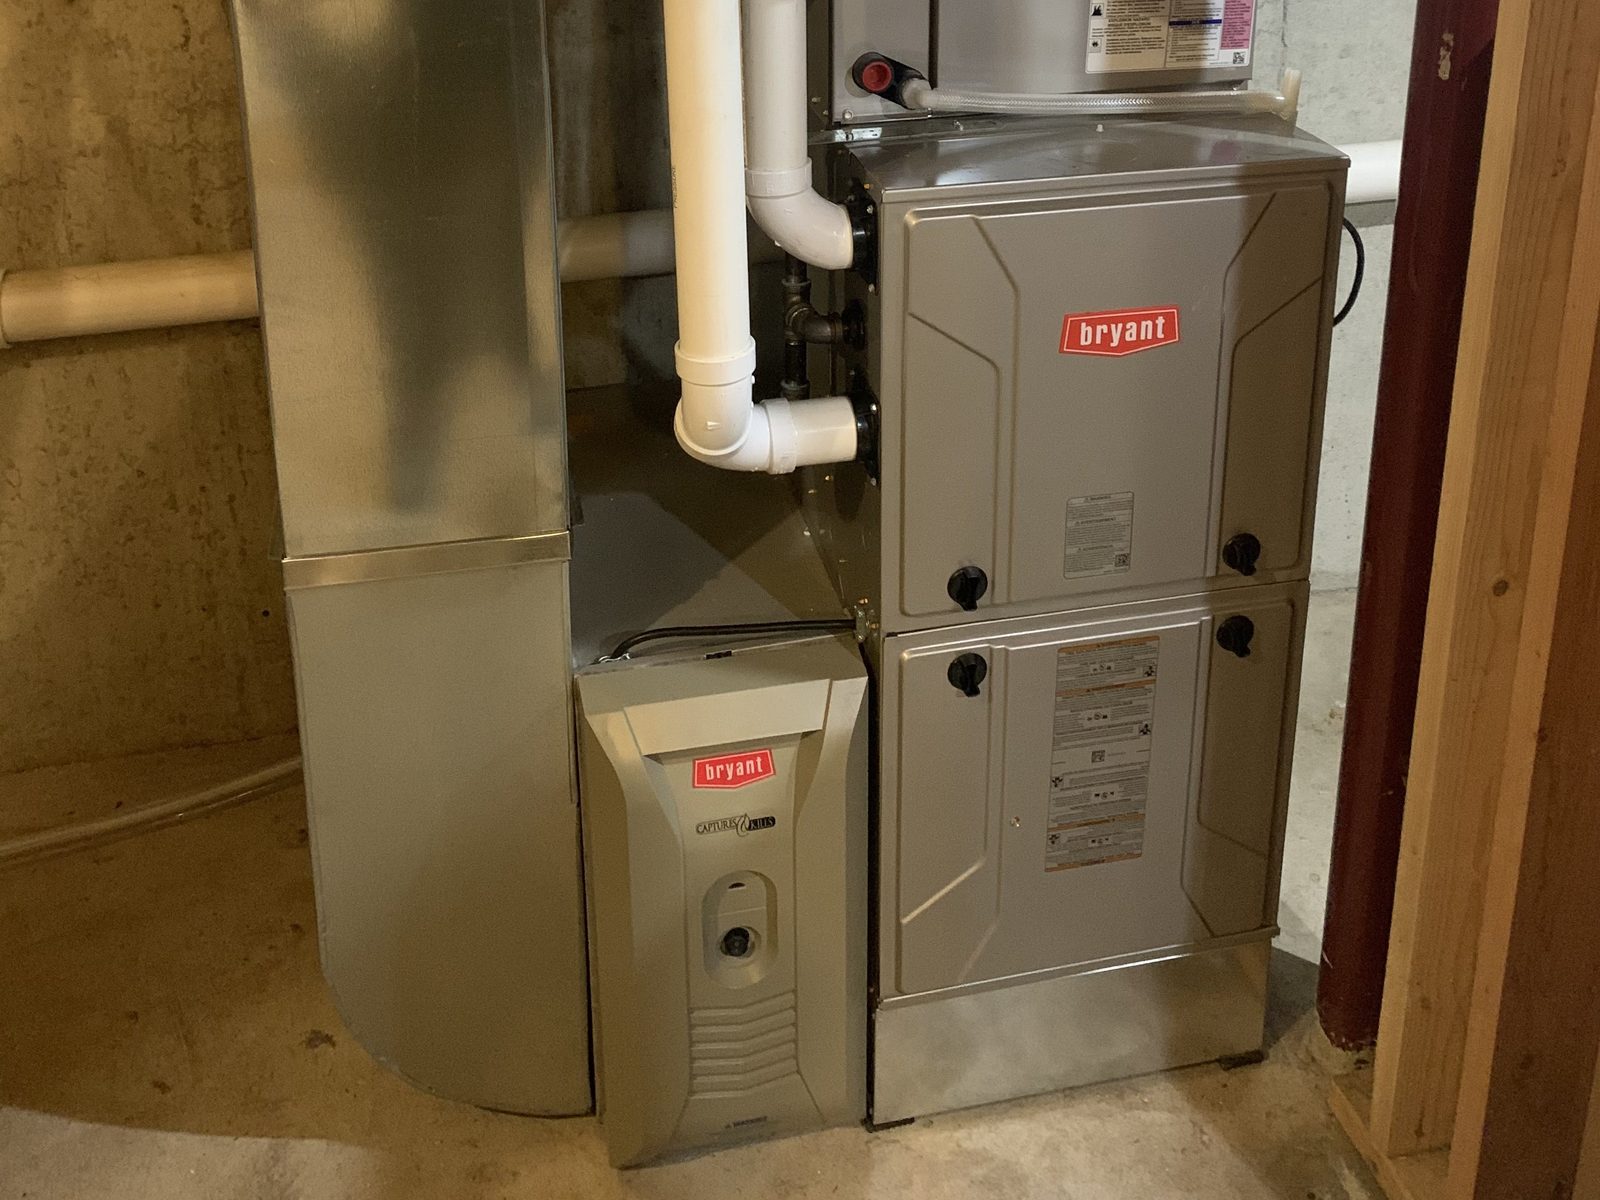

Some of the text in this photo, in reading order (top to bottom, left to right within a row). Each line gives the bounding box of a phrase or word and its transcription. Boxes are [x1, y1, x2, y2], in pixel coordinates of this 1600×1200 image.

[1080, 316, 1165, 347] bryant
[705, 756, 763, 781] bryant
[696, 818, 737, 834] CAPTURES
[751, 816, 774, 831] KILLS
